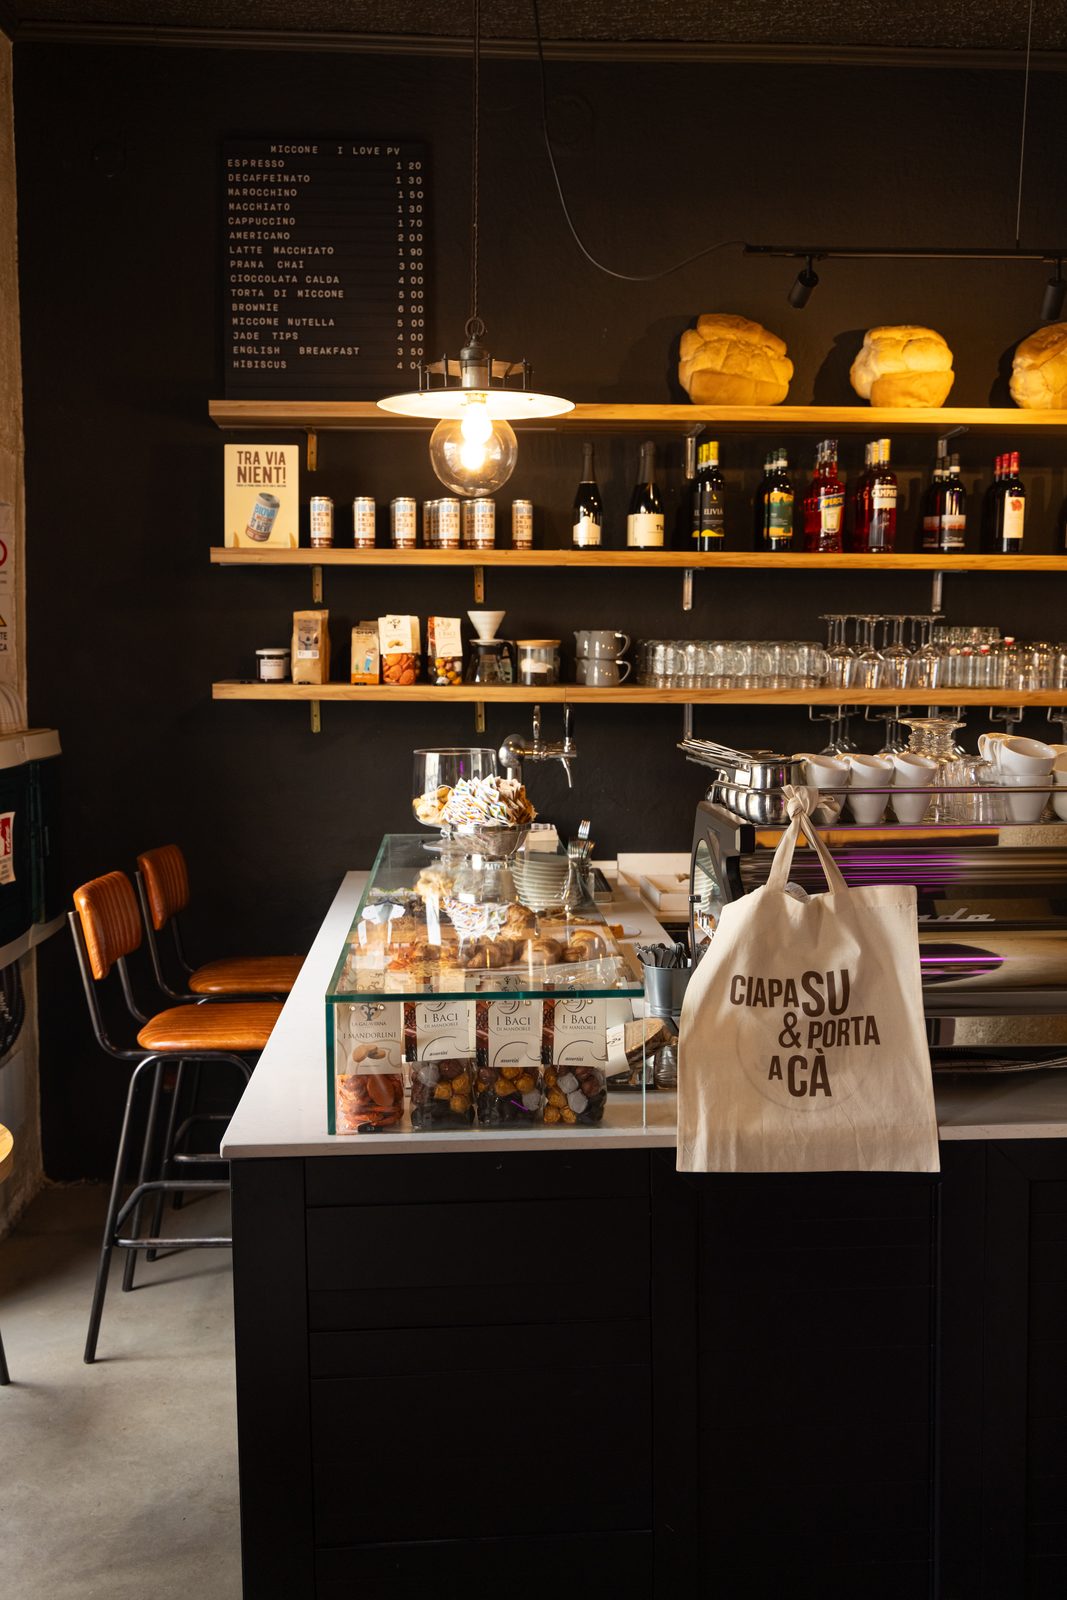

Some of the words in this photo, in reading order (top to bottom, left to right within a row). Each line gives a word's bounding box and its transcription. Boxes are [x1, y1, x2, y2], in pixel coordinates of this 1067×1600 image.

[270, 145, 318, 154] MICCONE
[338, 146, 342, 154] I
[227, 160, 284, 168] ESPRESSO
[228, 174, 310, 182] DECAFFEINATO
[228, 188, 297, 196] MAROCCHINO
[409, 205, 422, 213] 30
[228, 218, 296, 226] CAPPUCCINO
[273, 246, 334, 254] MACCHIATO
[410, 262, 423, 270] 00
[230, 274, 298, 282] CIOCCOLATA
[306, 276, 340, 284] CALDA
[410, 276, 424, 284] 00
[297, 290, 344, 298] MICCONE
[410, 290, 424, 298] 00
[232, 304, 278, 312] BROWNIE
[232, 318, 278, 326] MICCONE
[288, 318, 334, 326] NUTELLA
[411, 319, 424, 327] 00
[233, 332, 259, 340] JADE
[272, 332, 298, 340] TIPS
[410, 333, 424, 341] 00
[234, 346, 280, 354] ENGLISH
[299, 346, 360, 355] BREAKFAST
[234, 360, 286, 368] HIBISCUS
[237, 451, 260, 464] TRA
[266, 452, 286, 465] VIA
[237, 466, 286, 484] NIENT!
[730, 974, 800, 1008] CIAPA
[800, 968, 850, 1017] SU
[424, 1014, 428, 1023] I
[432, 1012, 458, 1022] BACI
[496, 1016, 500, 1026] I
[505, 1016, 531, 1026] BACI
[562, 1014, 566, 1024] I
[571, 1014, 596, 1025] BACI
[778, 1012, 801, 1048] &
[807, 1016, 880, 1048] PORTA
[768, 1056, 783, 1080] A
[787, 1048, 832, 1097] CÀ
